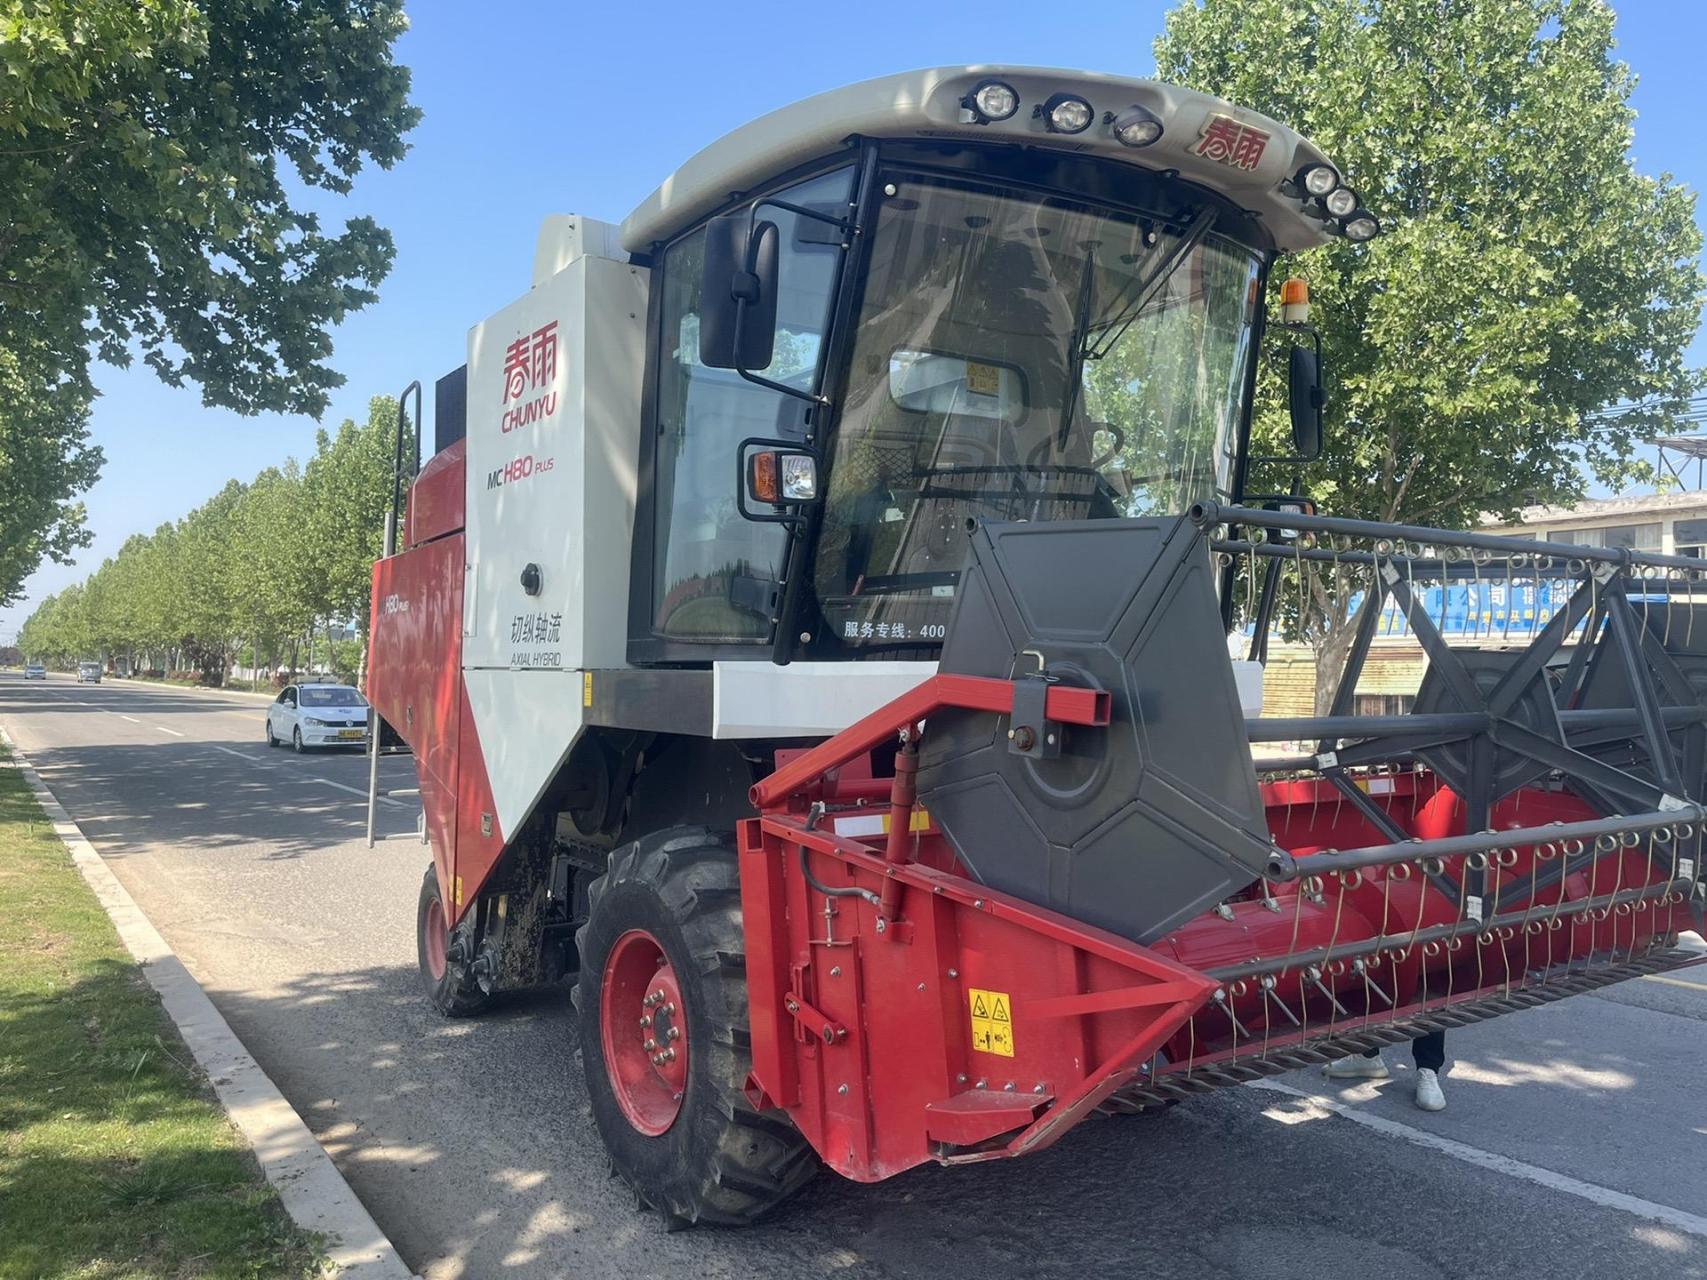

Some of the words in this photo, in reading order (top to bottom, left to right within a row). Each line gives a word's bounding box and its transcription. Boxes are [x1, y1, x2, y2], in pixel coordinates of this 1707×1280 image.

[1195, 115, 1272, 171] 春雨
[503, 320, 558, 404] 春雨
[501, 392, 556, 434] CHUNYU
[535, 457, 554, 475] PLUS
[511, 612, 562, 644] 切纵轴流
[511, 652, 531, 666] AXIAL
[532, 652, 561, 666] HYBRID
